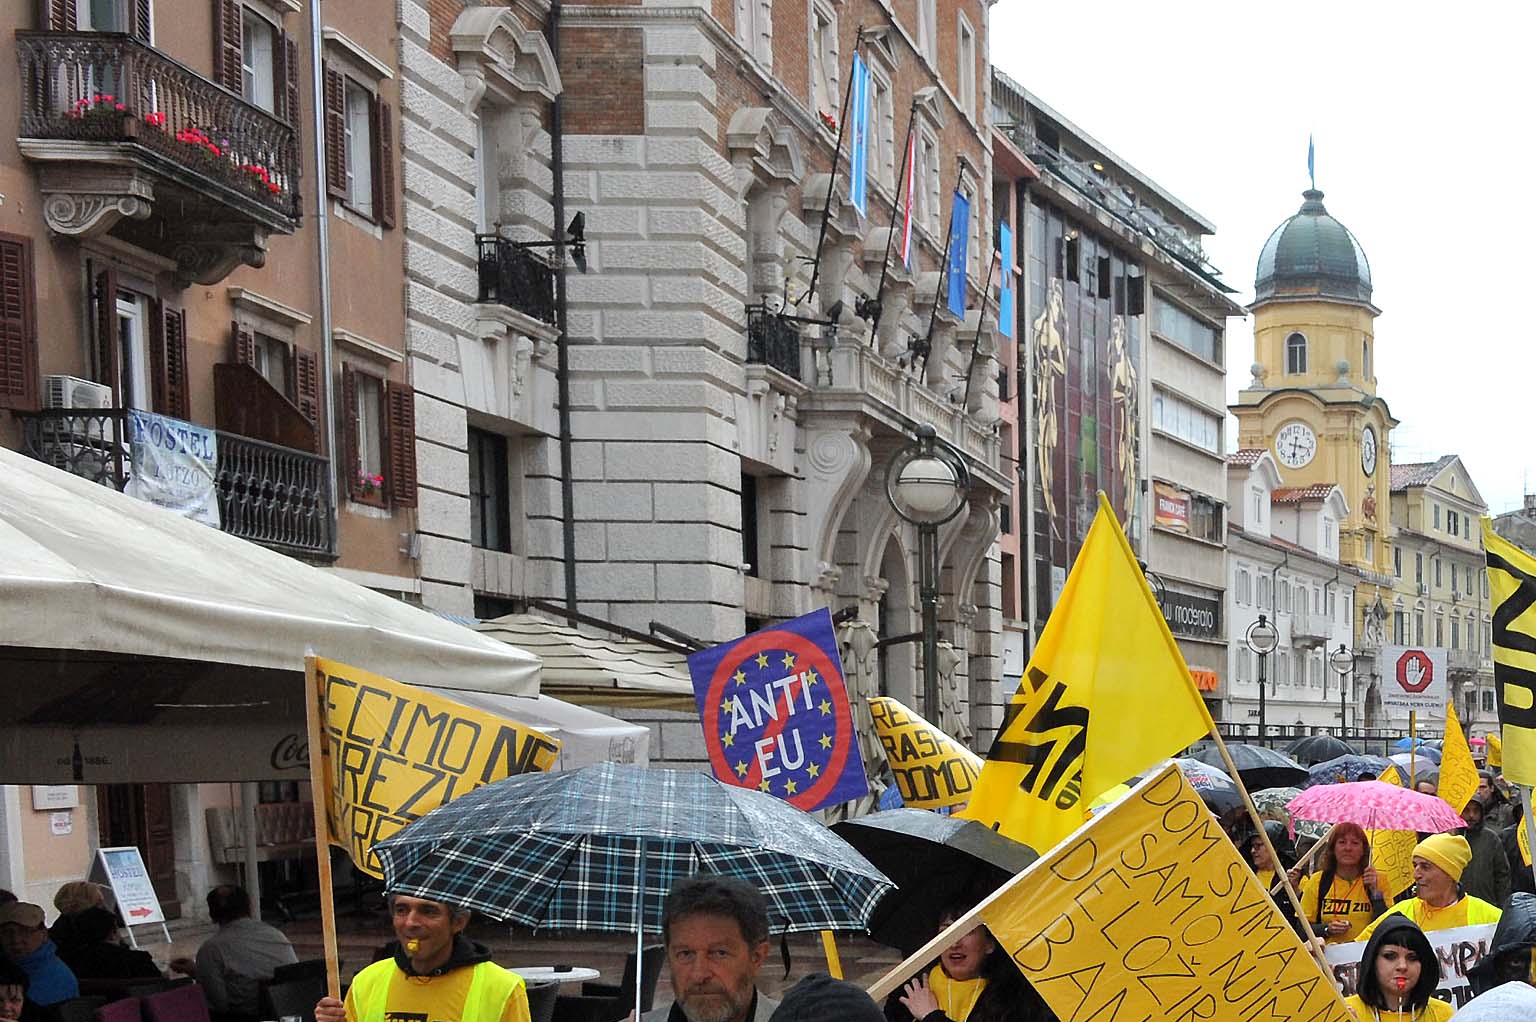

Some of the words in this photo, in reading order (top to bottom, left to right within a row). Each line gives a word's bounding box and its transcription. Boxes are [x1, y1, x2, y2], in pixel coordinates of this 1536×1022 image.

[729, 671, 815, 736] ANTI
[754, 728, 806, 780] EU
[1141, 768, 1222, 863] DOM
[1121, 832, 1224, 947] SAMO
[1322, 897, 1350, 914] ŽIVI
